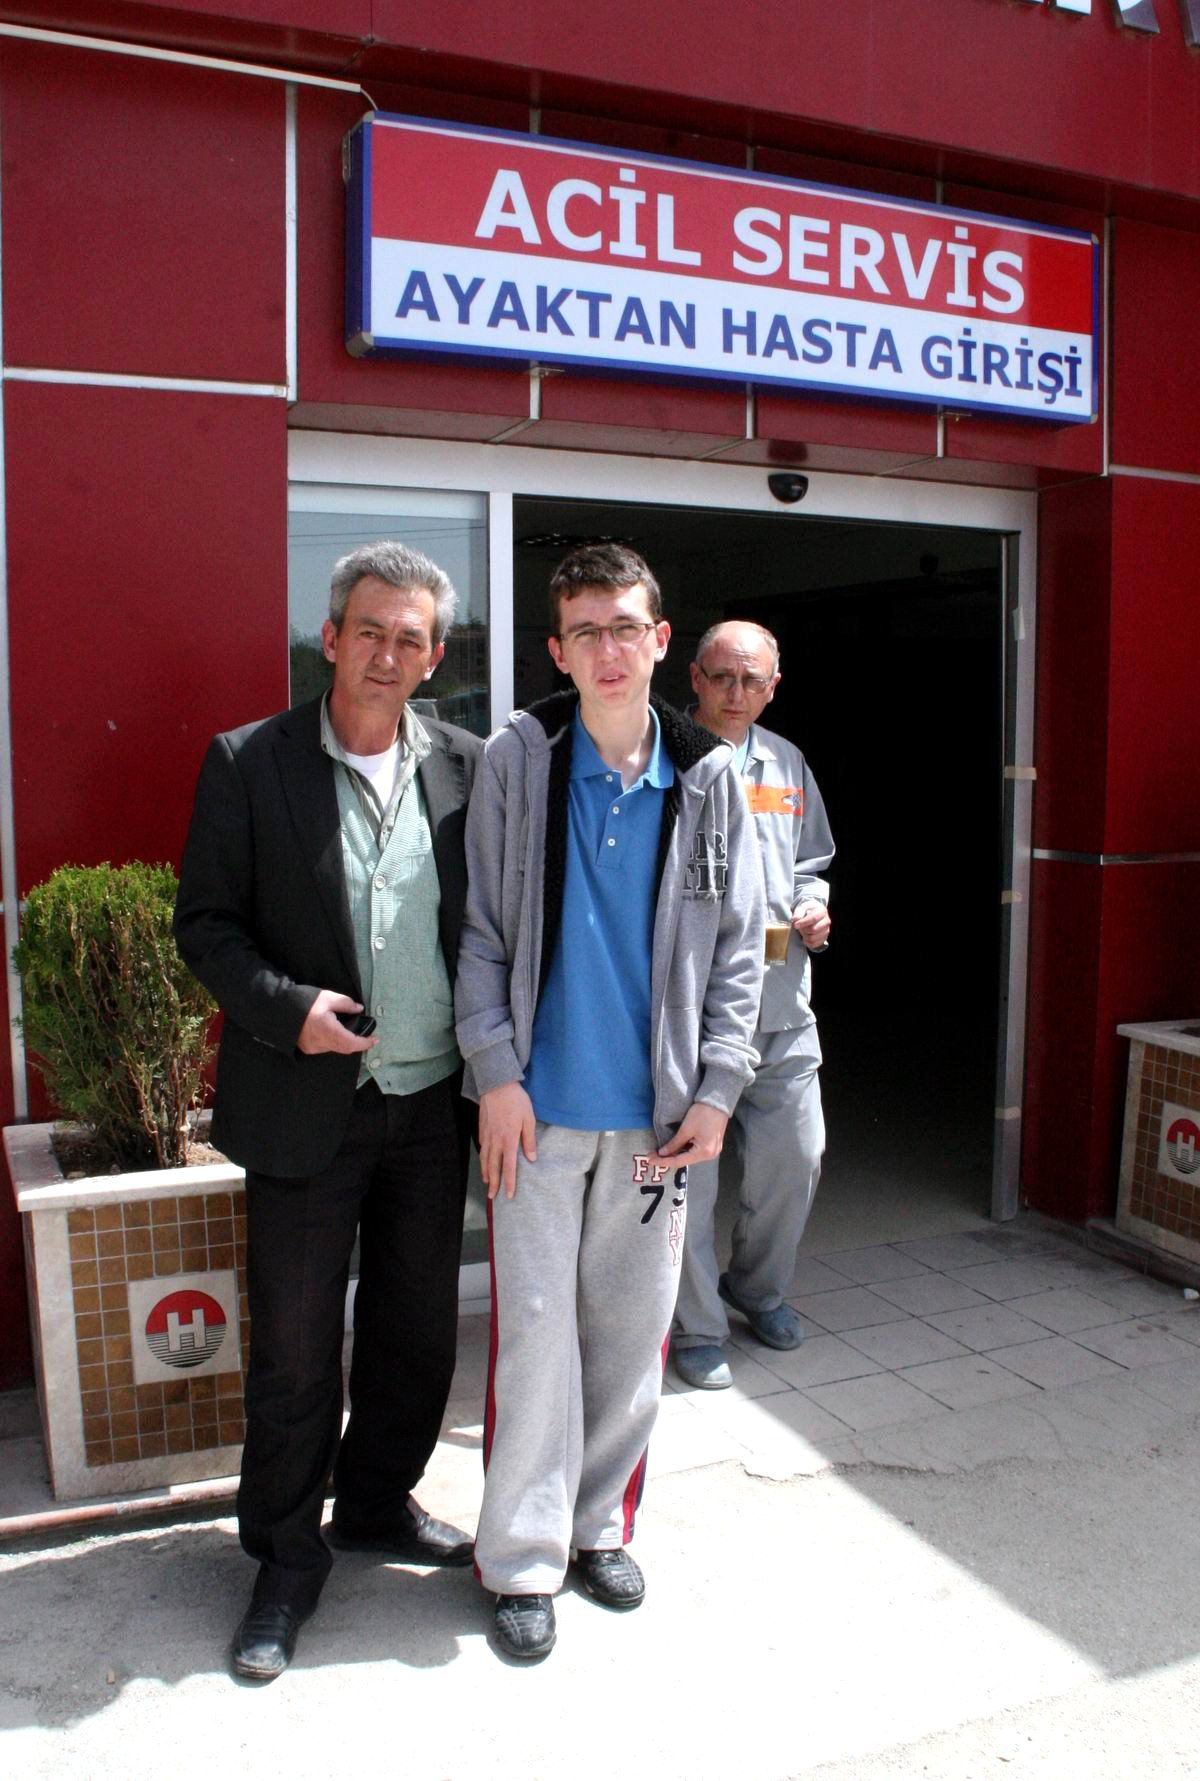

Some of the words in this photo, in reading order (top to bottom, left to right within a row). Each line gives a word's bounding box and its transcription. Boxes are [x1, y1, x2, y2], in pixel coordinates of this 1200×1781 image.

[474, 167, 701, 266] ACİL
[732, 206, 1025, 313] SERVİS
[395, 270, 696, 350] AYAKTAN
[721, 308, 903, 374] HASTA
[920, 327, 1083, 404] GİRİŞİ
[166, 1308, 207, 1352] H
